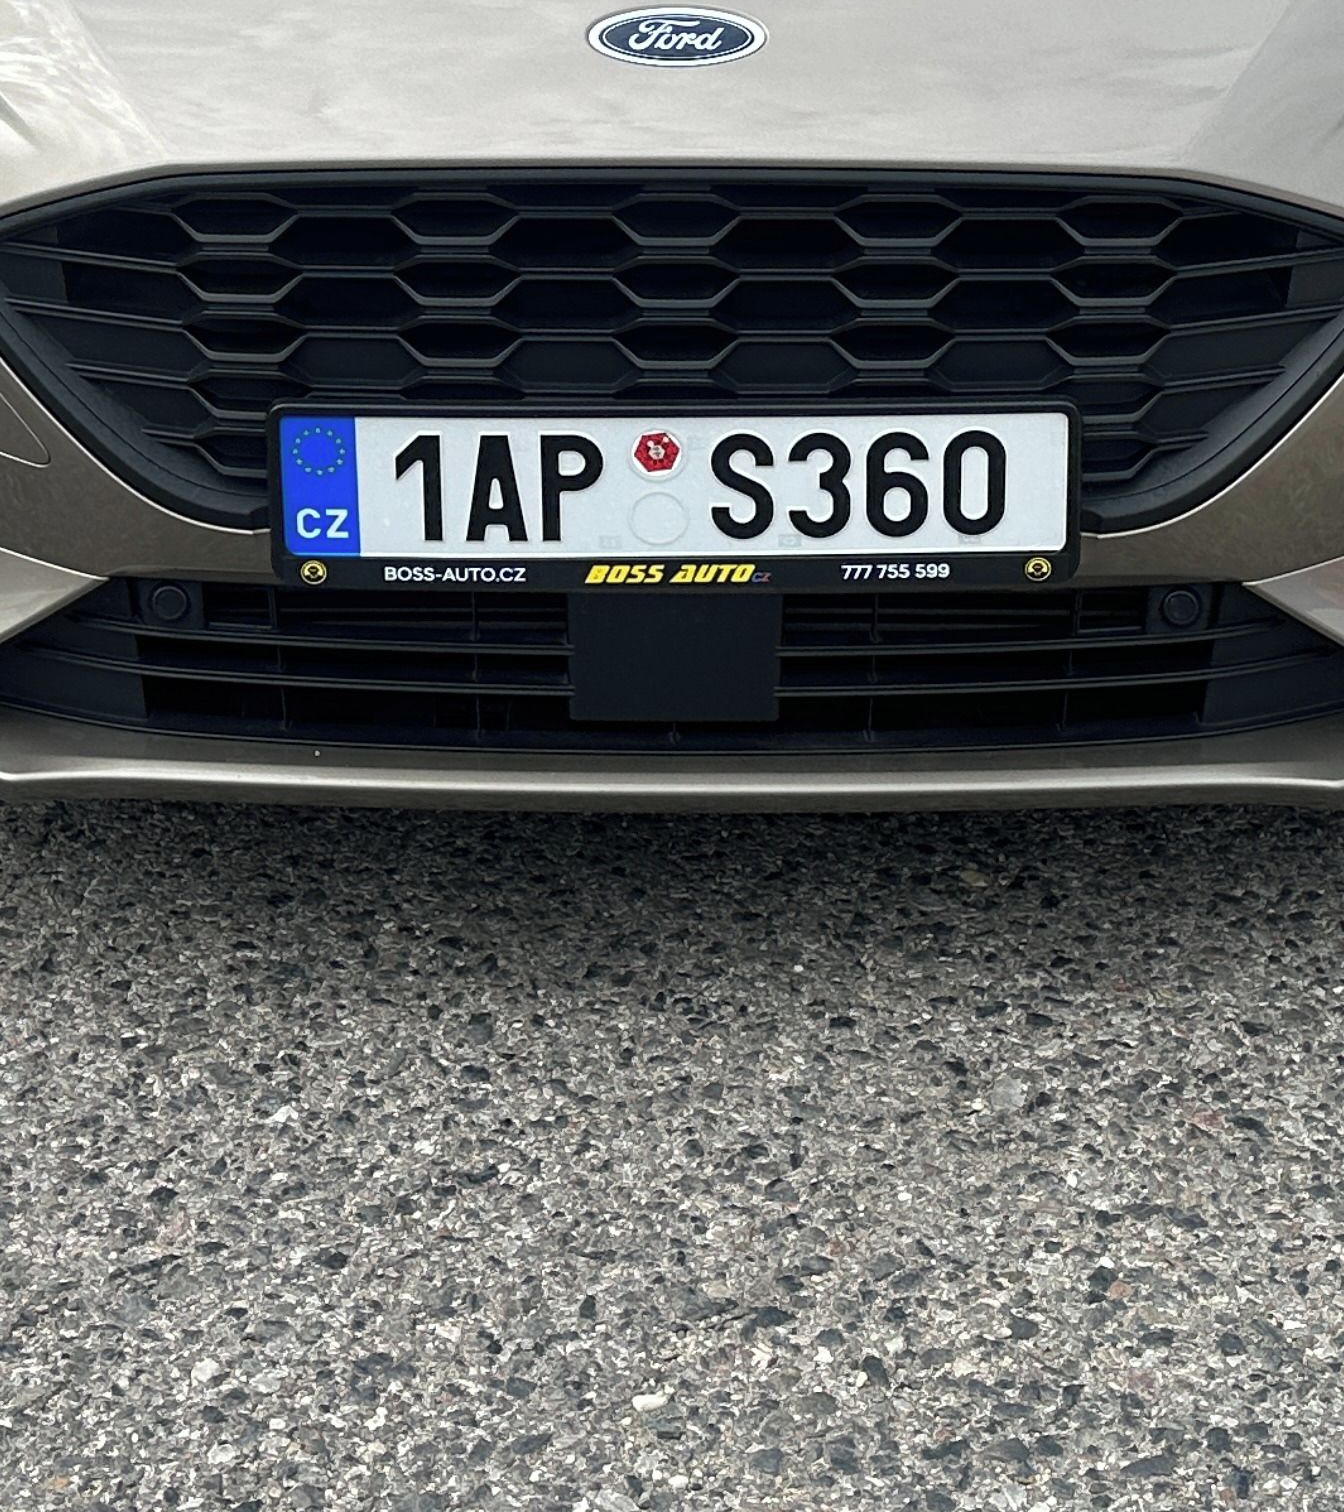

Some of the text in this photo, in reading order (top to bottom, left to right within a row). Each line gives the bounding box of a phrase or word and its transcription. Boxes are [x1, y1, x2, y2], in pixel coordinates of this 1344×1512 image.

[628, 18, 725, 50] Ford
[394, 429, 1007, 542] 1AP S360
[296, 507, 350, 539] CZ
[383, 565, 527, 583] BOSS-AUTO.CZ
[584, 564, 664, 584] BOSS
[669, 563, 755, 584] AUTO
[840, 562, 951, 580] 777 755 599
